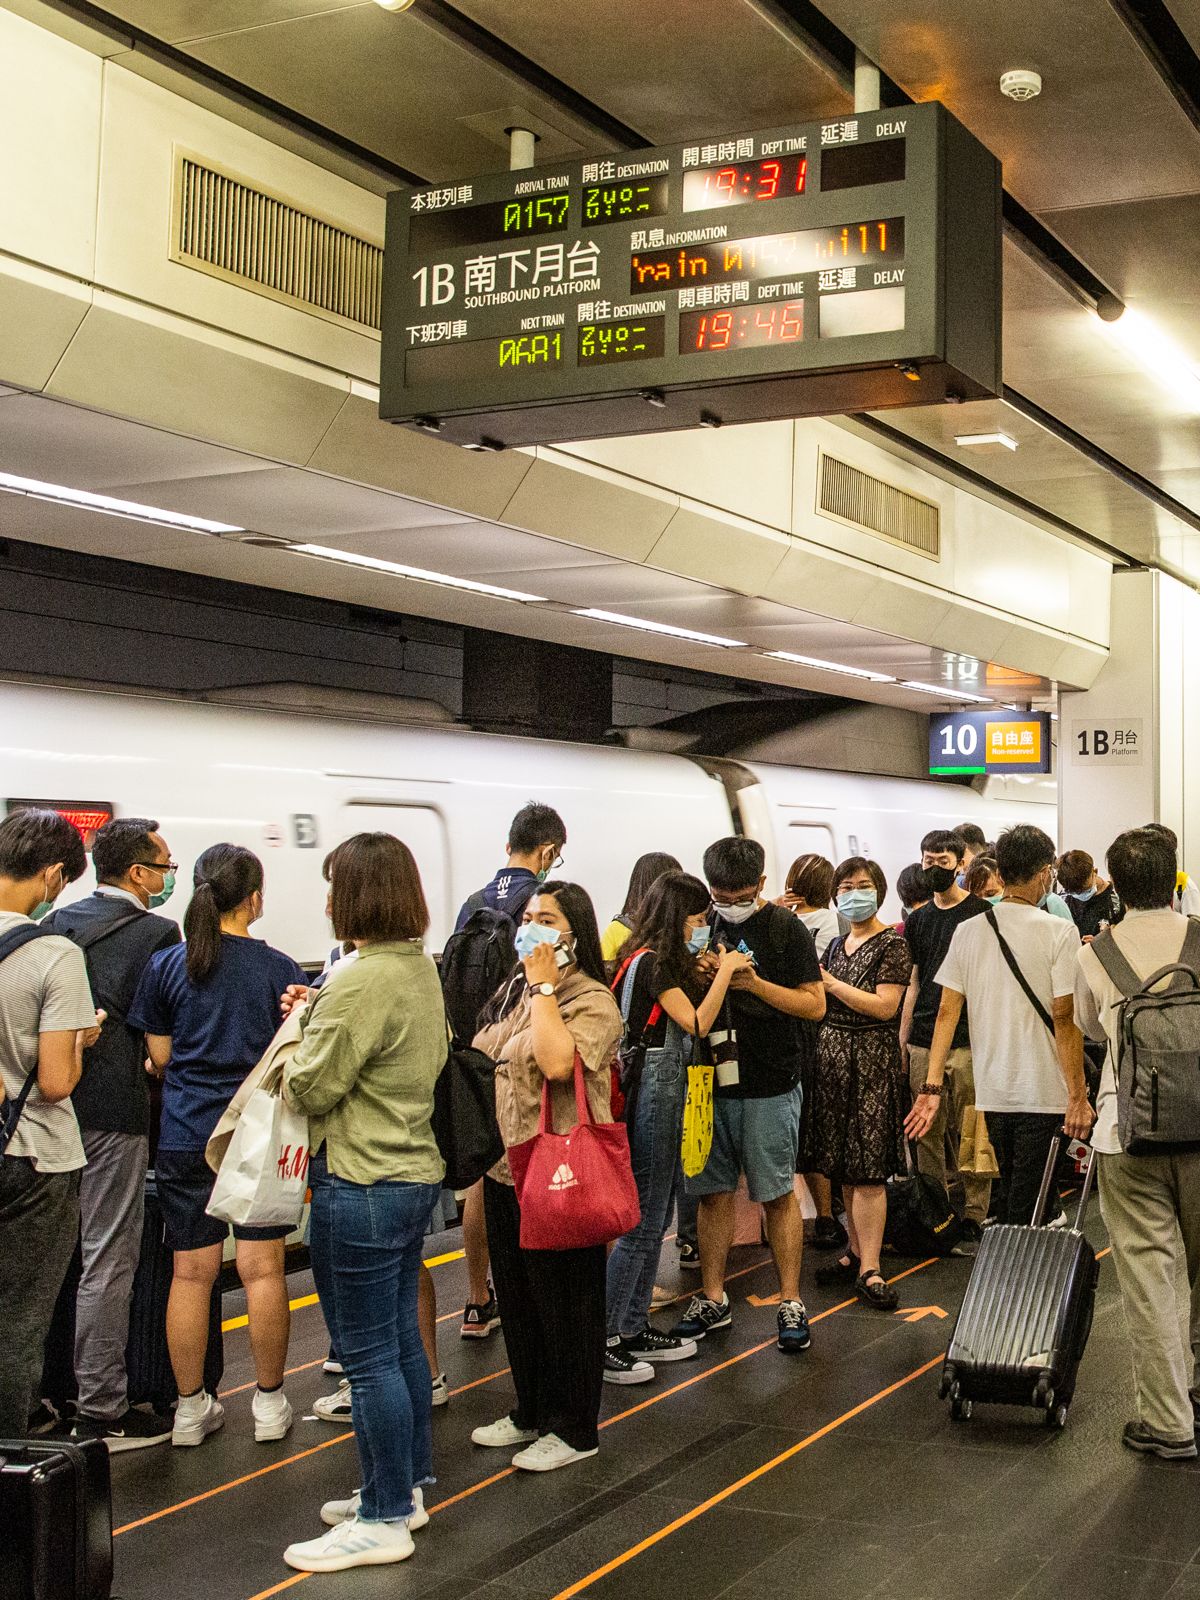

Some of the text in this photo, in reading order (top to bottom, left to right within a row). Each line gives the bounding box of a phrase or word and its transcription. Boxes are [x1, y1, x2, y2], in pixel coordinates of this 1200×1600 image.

[821, 121, 859, 145] 延遲
[876, 121, 907, 137] DELAY
[682, 138, 754, 168] 開車時間
[762, 137, 807, 155] DEPT TIME
[582, 161, 616, 183] 開往
[617, 159, 669, 178] DESTINATION
[514, 175, 570, 195] ARRIVAL TRAIN
[702, 160, 807, 202] 19:31
[411, 185, 473, 212] 本班列車
[630, 228, 665, 250] 訊息
[666, 225, 727, 246] INFORMATION
[464, 240, 601, 295] 南下月台
[873, 269, 905, 286] DELAY
[412, 263, 455, 307] 1B
[818, 267, 856, 291] 延遲
[464, 278, 601, 309] SOUTHBOUND PLATFORM
[678, 282, 750, 309] 開車時間
[758, 282, 804, 299] DEPT TIME
[577, 300, 611, 322] 開往
[613, 300, 666, 318] DESTINATION
[406, 320, 468, 345] 下班列車
[520, 313, 565, 330] NEXT TRAIN
[696, 303, 802, 349] 19:46
[939, 724, 978, 755] 10
[992, 730, 1034, 746] 自由座
[1077, 729, 1109, 756] 1B
[1112, 729, 1138, 746] 月台
[1111, 748, 1138, 756] Platform
[277, 1144, 309, 1181] H&M
